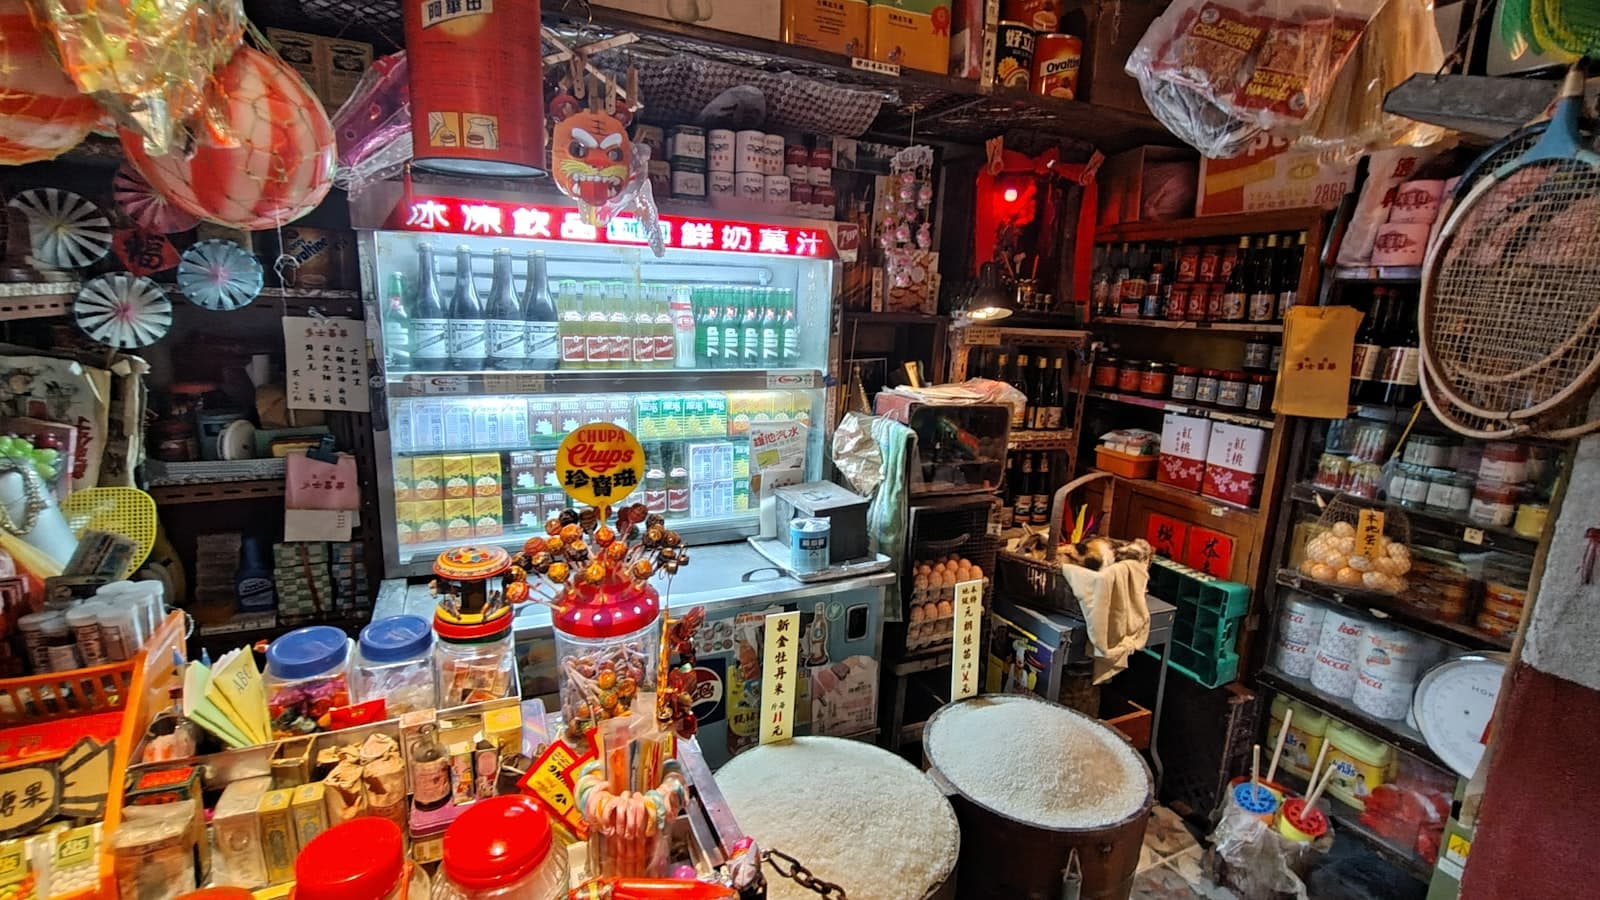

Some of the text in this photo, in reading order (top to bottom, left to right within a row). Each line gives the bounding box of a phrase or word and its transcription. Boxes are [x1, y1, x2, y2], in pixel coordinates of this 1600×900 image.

[1005, 29, 1035, 53] 好立
[681, 221, 824, 255] 鮮奶菓汁
[707, 326, 719, 357] 7UP
[725, 327, 738, 358] 7UP
[744, 327, 758, 358] 7UP
[763, 328, 778, 359] 7UP
[577, 429, 625, 444] CHUPA
[1180, 426, 1193, 454] 紅桃
[1232, 437, 1247, 466] 紅桃
[566, 443, 634, 473] Chups
[565, 468, 637, 497] 珍寶珠
[774, 619, 790, 696] 新金牡丹米
[231, 663, 254, 695] ABC
